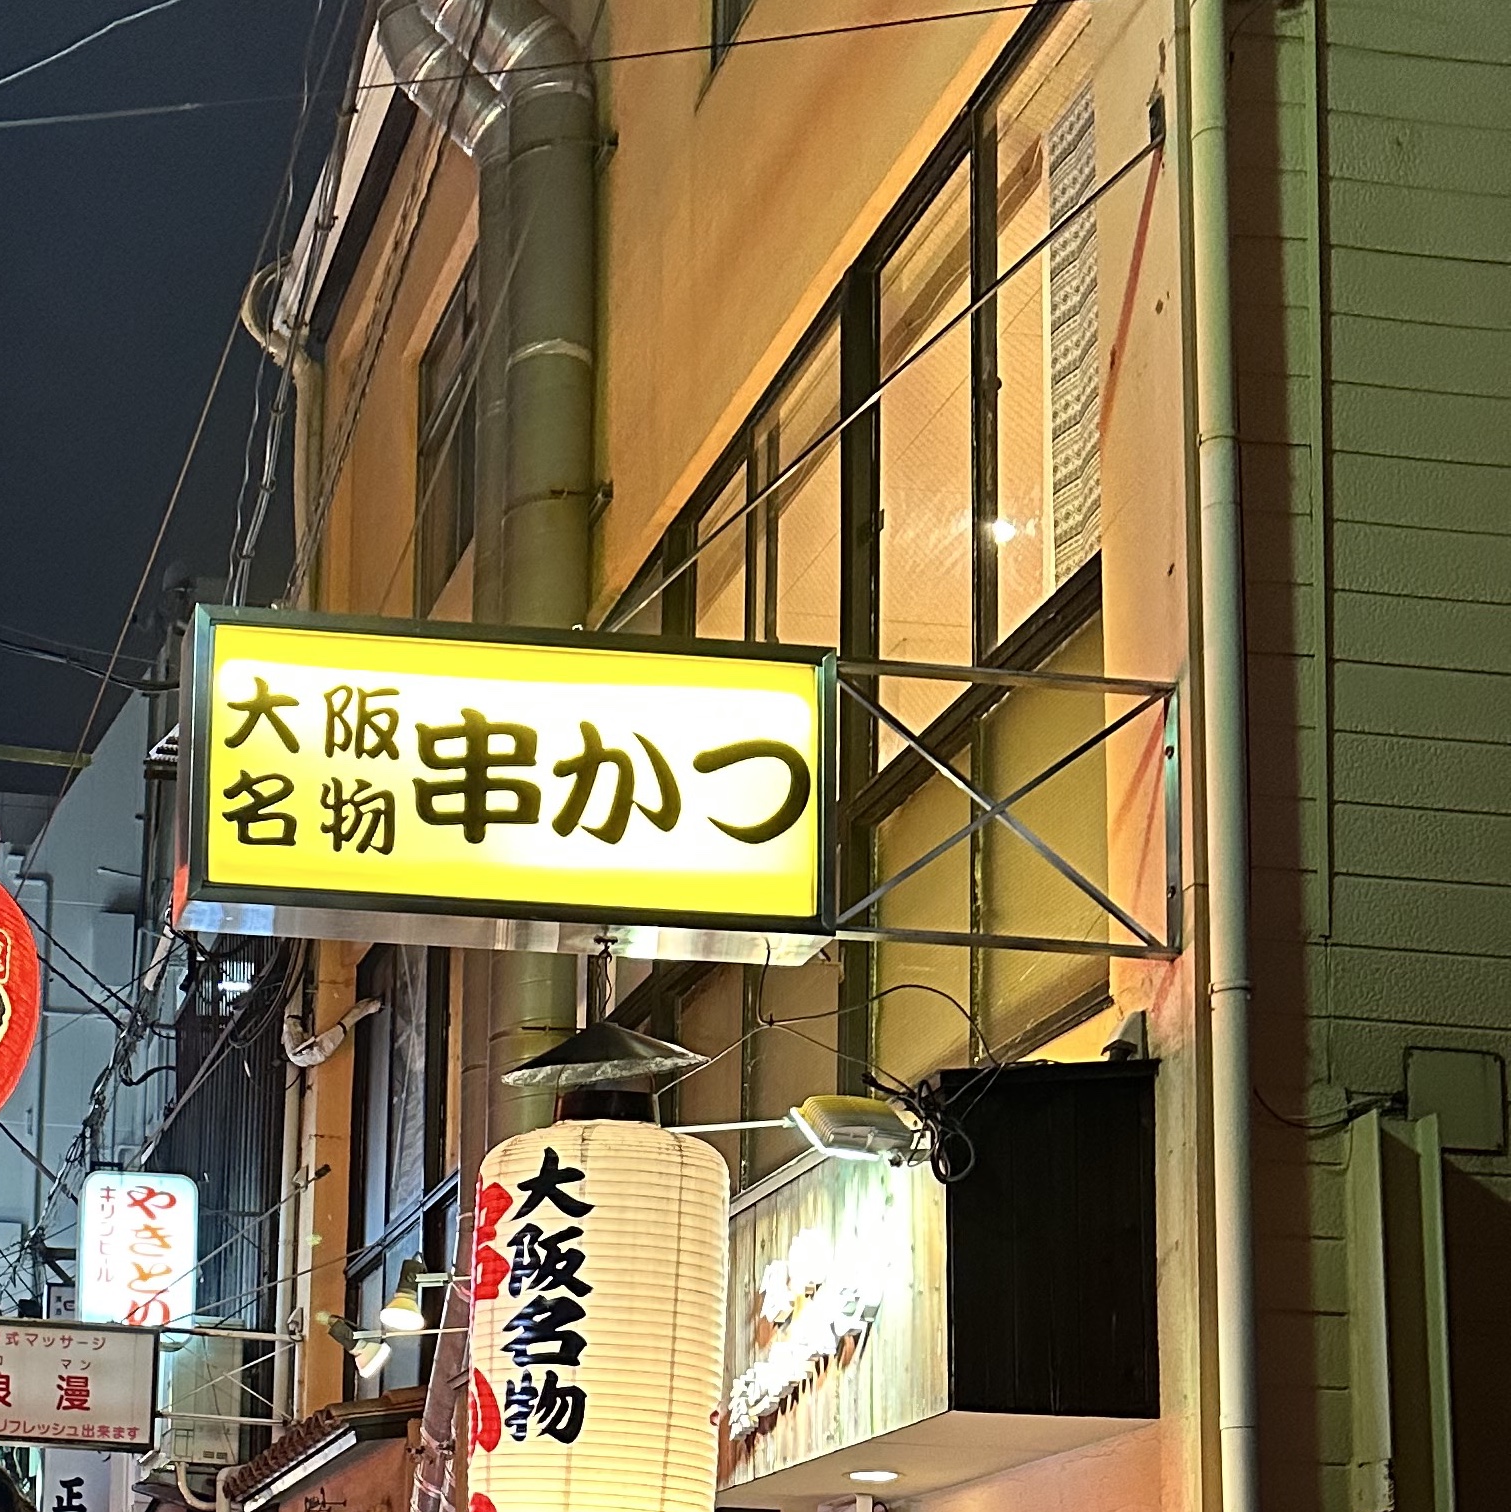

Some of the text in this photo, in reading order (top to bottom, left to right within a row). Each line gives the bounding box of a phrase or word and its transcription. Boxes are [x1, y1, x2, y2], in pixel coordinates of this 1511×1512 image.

[221, 768, 396, 856] 名物
[223, 677, 811, 846] 大阪 串かつ
[500, 1147, 595, 1445] 大阪名物
